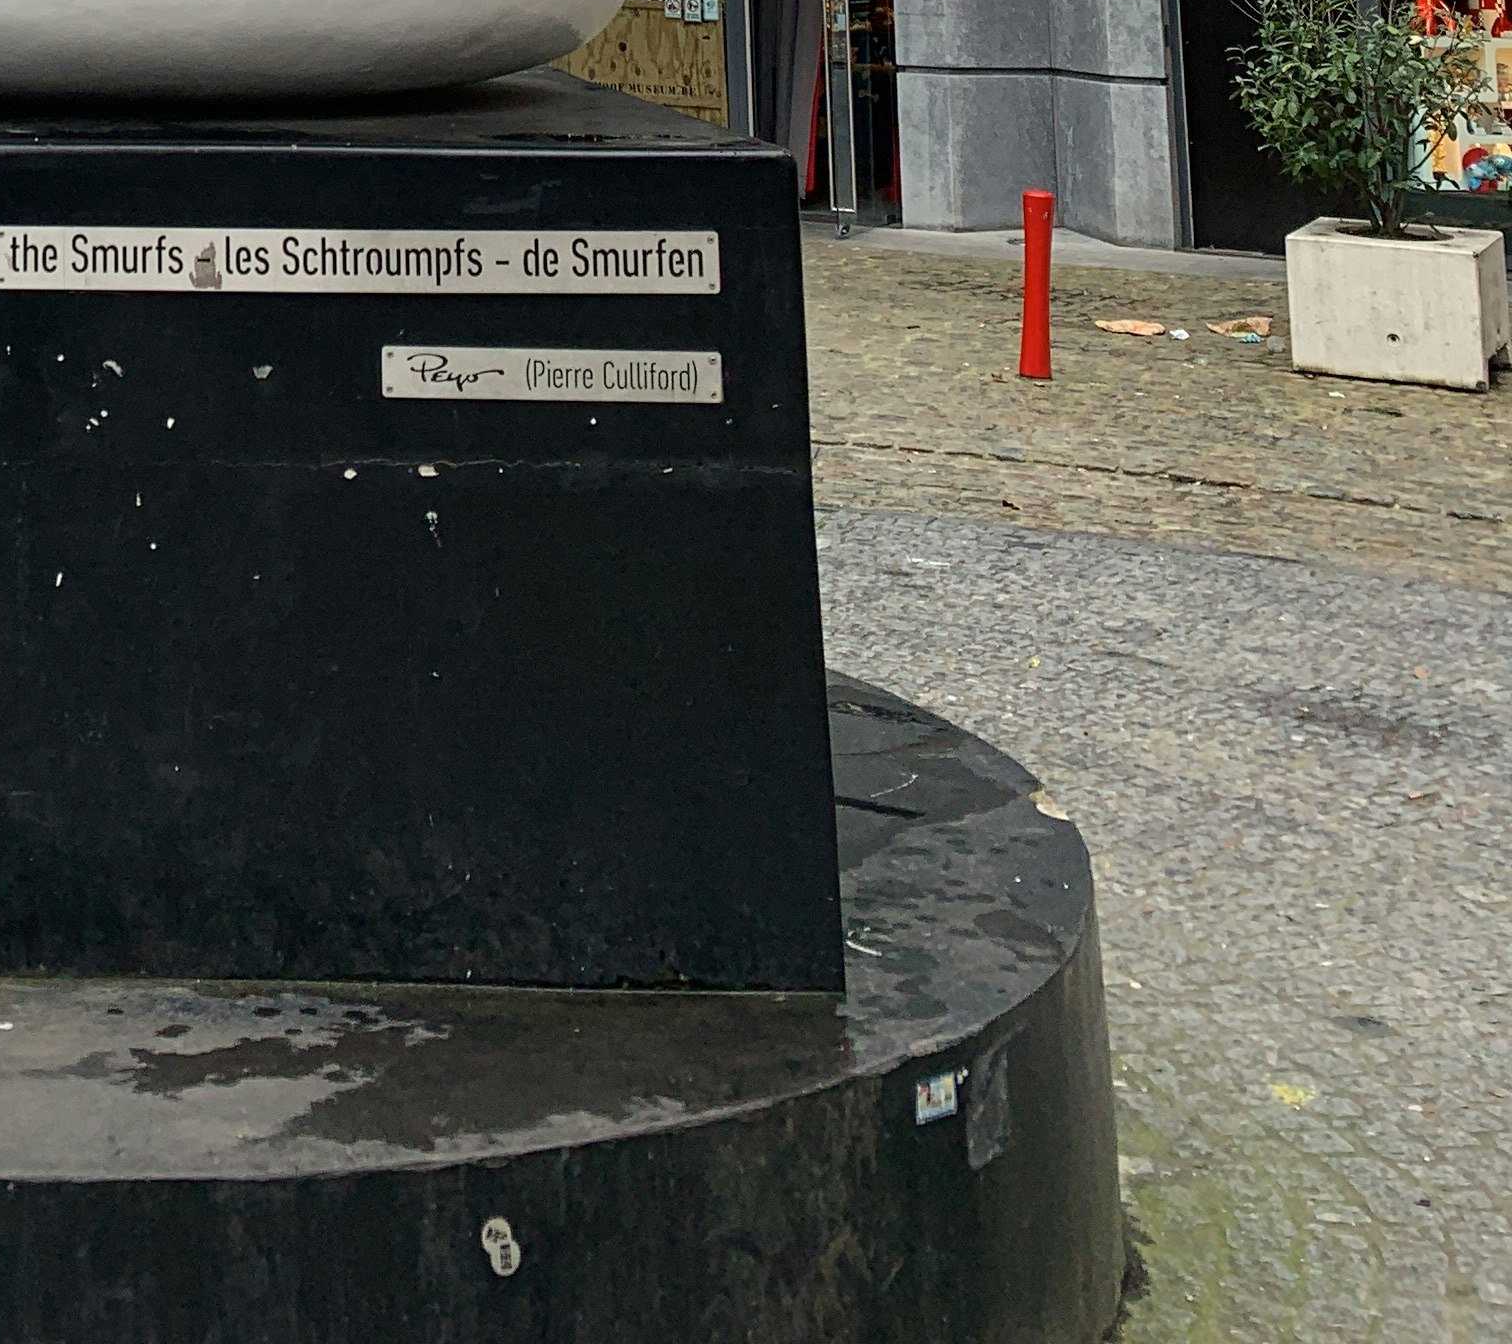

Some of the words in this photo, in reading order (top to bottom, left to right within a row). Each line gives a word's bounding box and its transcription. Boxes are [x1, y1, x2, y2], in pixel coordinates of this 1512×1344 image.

[10, 233, 58, 273] the
[71, 233, 185, 275] Smurfs
[225, 235, 271, 276] les
[282, 235, 483, 286] Schtroumpfs
[523, 238, 560, 278] de
[572, 238, 705, 279] Smurfen
[525, 358, 594, 391] (Pierre
[602, 359, 699, 395] Culliford)
